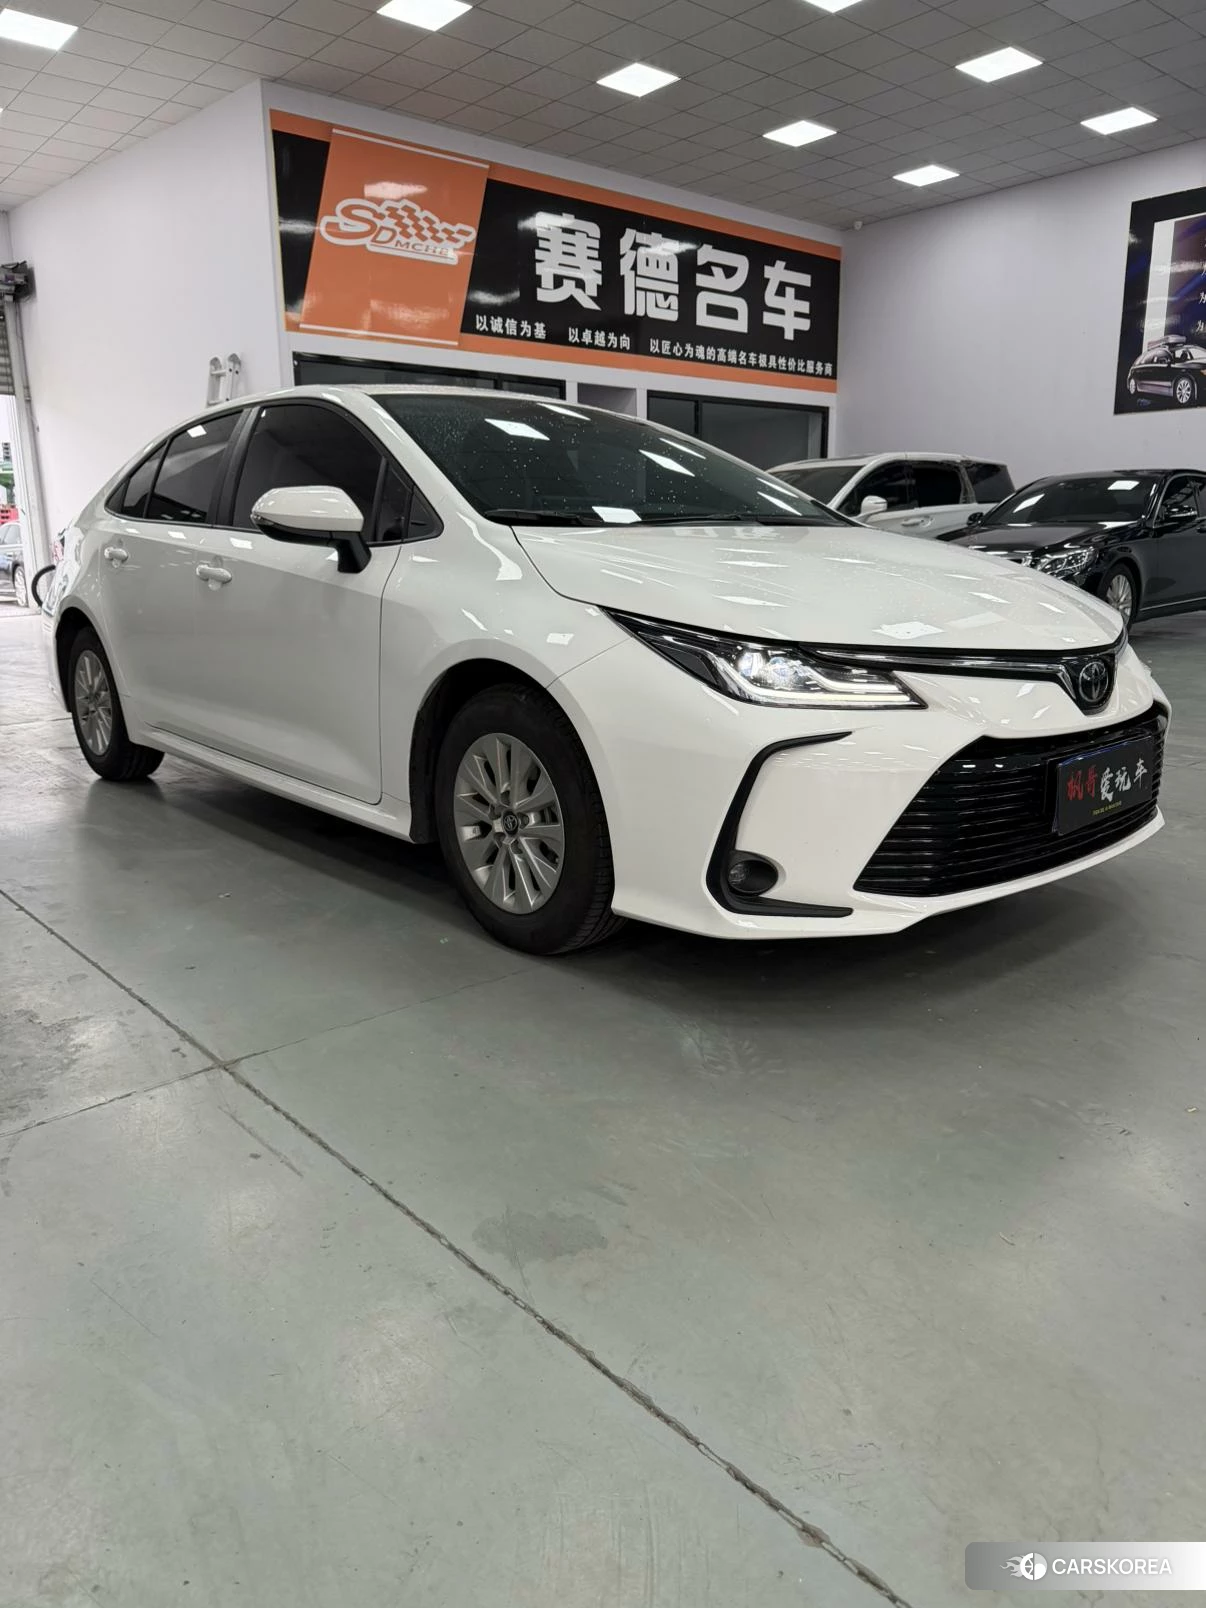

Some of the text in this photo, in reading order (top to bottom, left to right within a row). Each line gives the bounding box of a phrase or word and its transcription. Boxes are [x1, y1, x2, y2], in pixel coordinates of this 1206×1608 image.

[534, 211, 811, 341] 赛德名车
[475, 314, 547, 340] 以诚信为基
[568, 327, 631, 350] 以卓越为向
[650, 338, 833, 376] 以匠心为魂的高端名车极具性价比服务商
